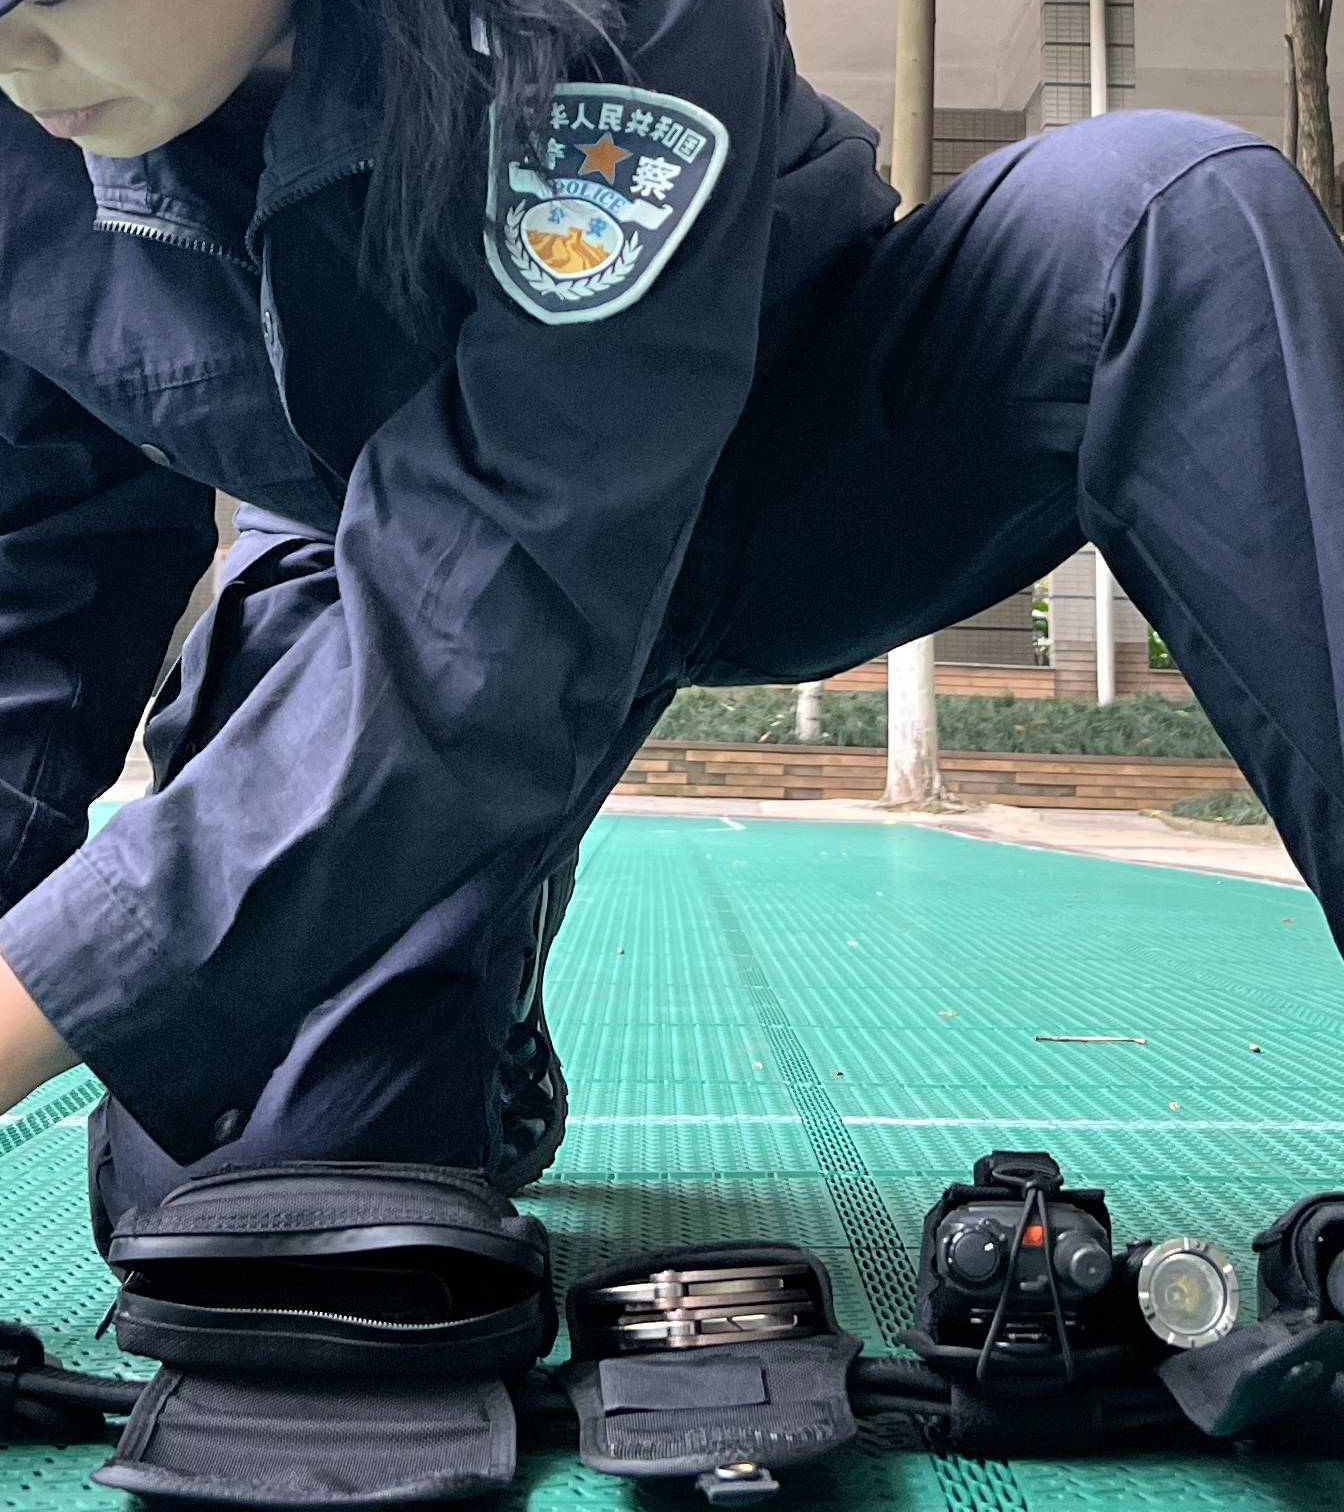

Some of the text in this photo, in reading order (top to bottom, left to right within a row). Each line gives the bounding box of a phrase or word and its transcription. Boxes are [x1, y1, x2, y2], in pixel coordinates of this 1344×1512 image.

[522, 102, 707, 165] 华人民共和国
